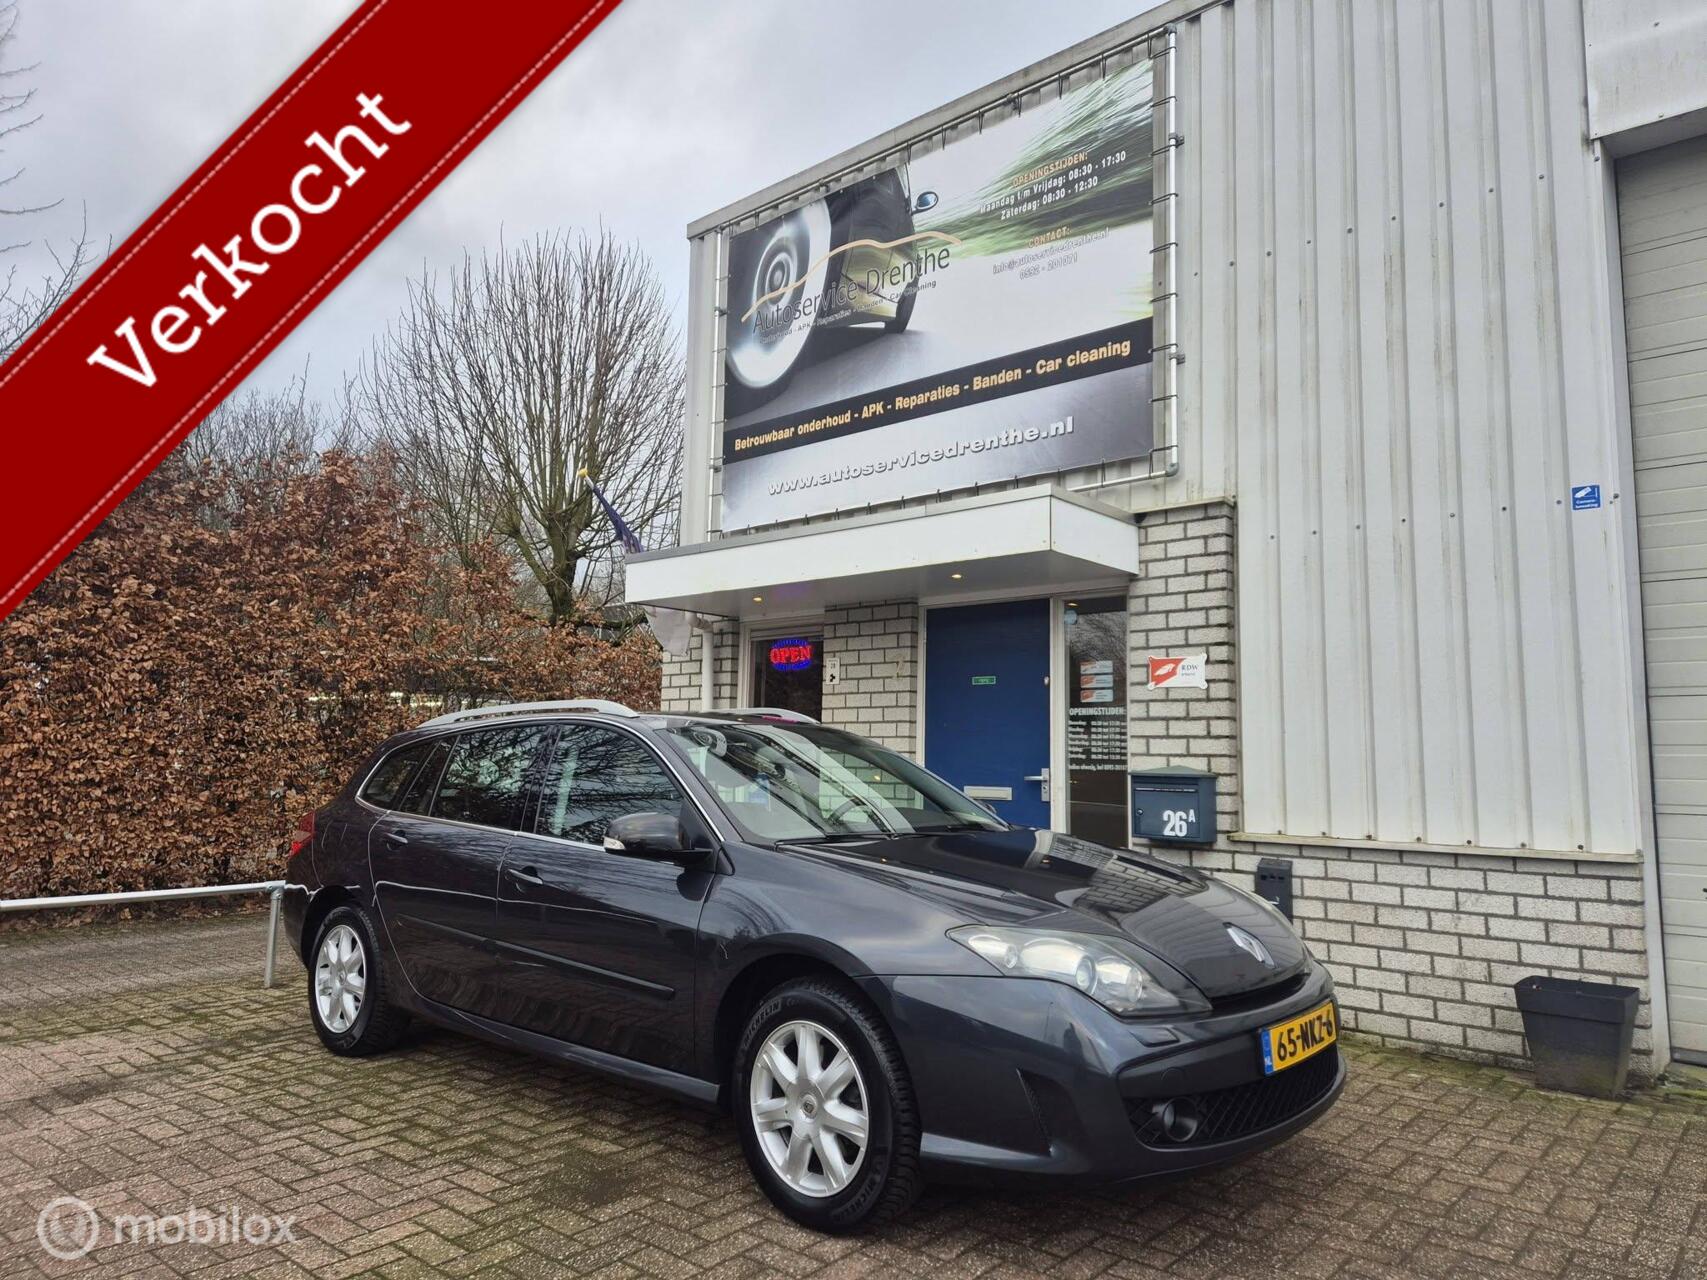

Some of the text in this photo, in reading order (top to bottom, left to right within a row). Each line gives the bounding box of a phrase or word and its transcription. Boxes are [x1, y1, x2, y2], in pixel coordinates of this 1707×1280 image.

[980, 195, 1015, 213] Maandag
[1033, 175, 1066, 193] Vrijdag:
[1068, 163, 1092, 181] 08:30
[1101, 151, 1126, 168] 17:30
[1013, 152, 1088, 187] OPENINGSTIJDEN:
[1001, 200, 1040, 220] Zaterdag:
[1042, 188, 1066, 204] 08:30
[1074, 176, 1098, 193] 12:30
[753, 247, 950, 333] Autoservice Drenthe
[734, 426, 795, 451] Betrouwbaar
[797, 410, 851, 435] onderhoud
[861, 401, 884, 420] APK
[895, 383, 960, 411] Reparaties
[973, 367, 1022, 391] Banden
[1035, 357, 1062, 375] Car
[1066, 339, 1131, 367] cleaning
[768, 416, 1074, 496] www.autoservicedrenthe.nl
[769, 645, 812, 665] OPEN
[743, 1000, 780, 1048] MICHELIN
[1277, 1009, 1334, 1062] 65-NKZ-6
